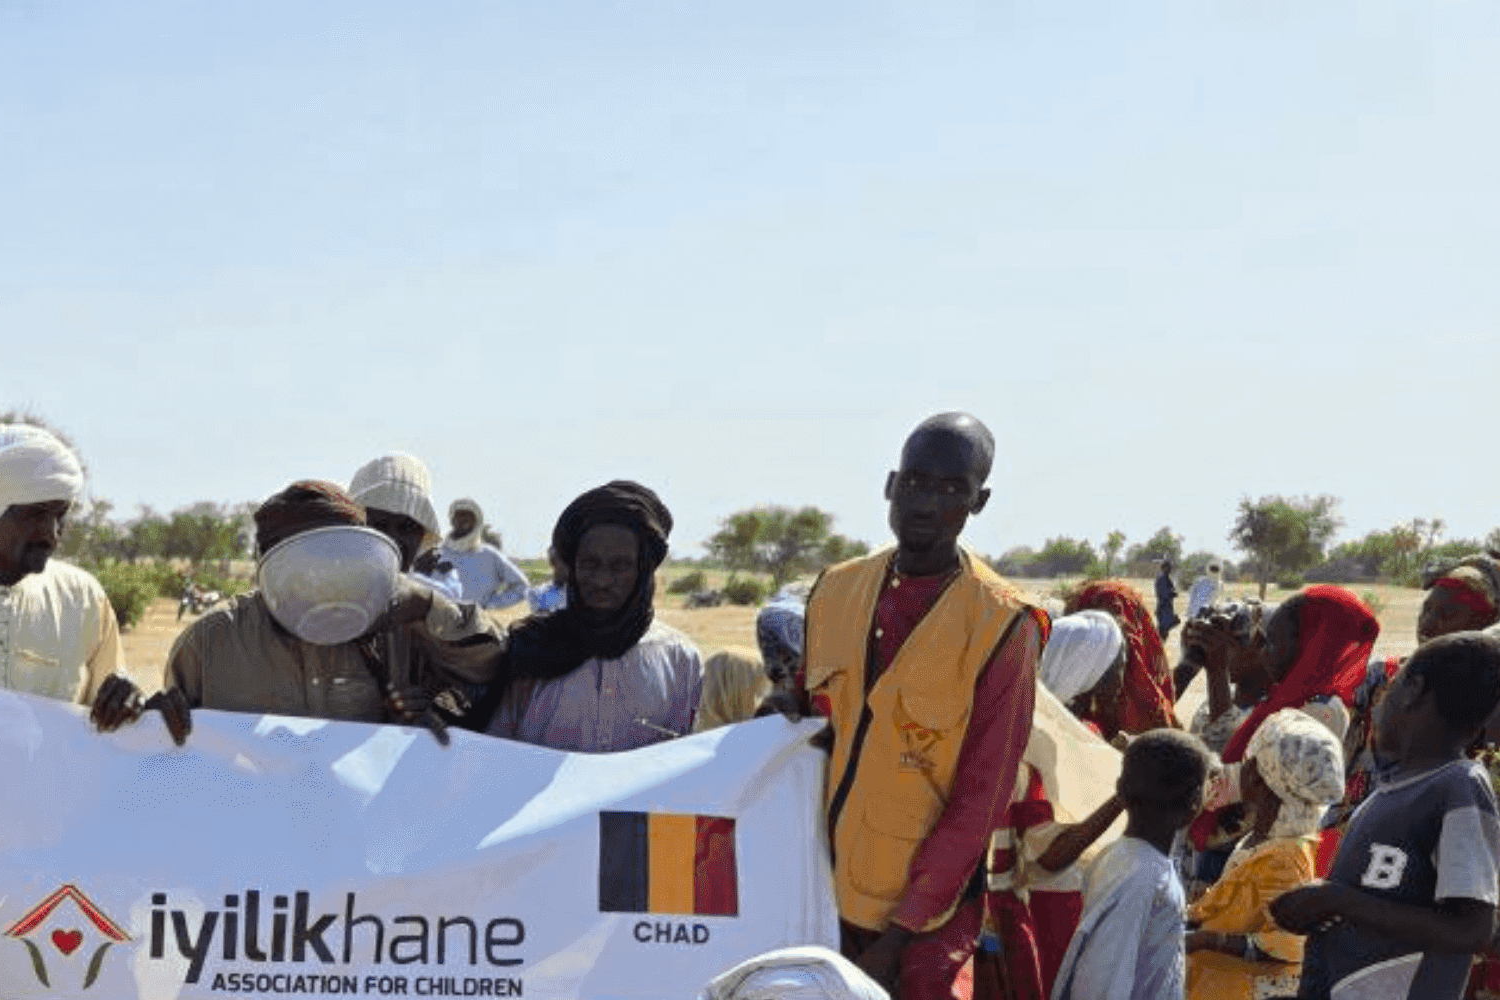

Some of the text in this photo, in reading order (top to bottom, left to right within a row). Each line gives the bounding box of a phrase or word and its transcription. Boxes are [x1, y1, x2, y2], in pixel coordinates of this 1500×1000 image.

[1361, 842, 1407, 889] B
[150, 889, 526, 983] iyilikhane
[633, 920, 711, 944] CHAD
[211, 972, 523, 997] ASSOCIATION FOR CHILDREN
